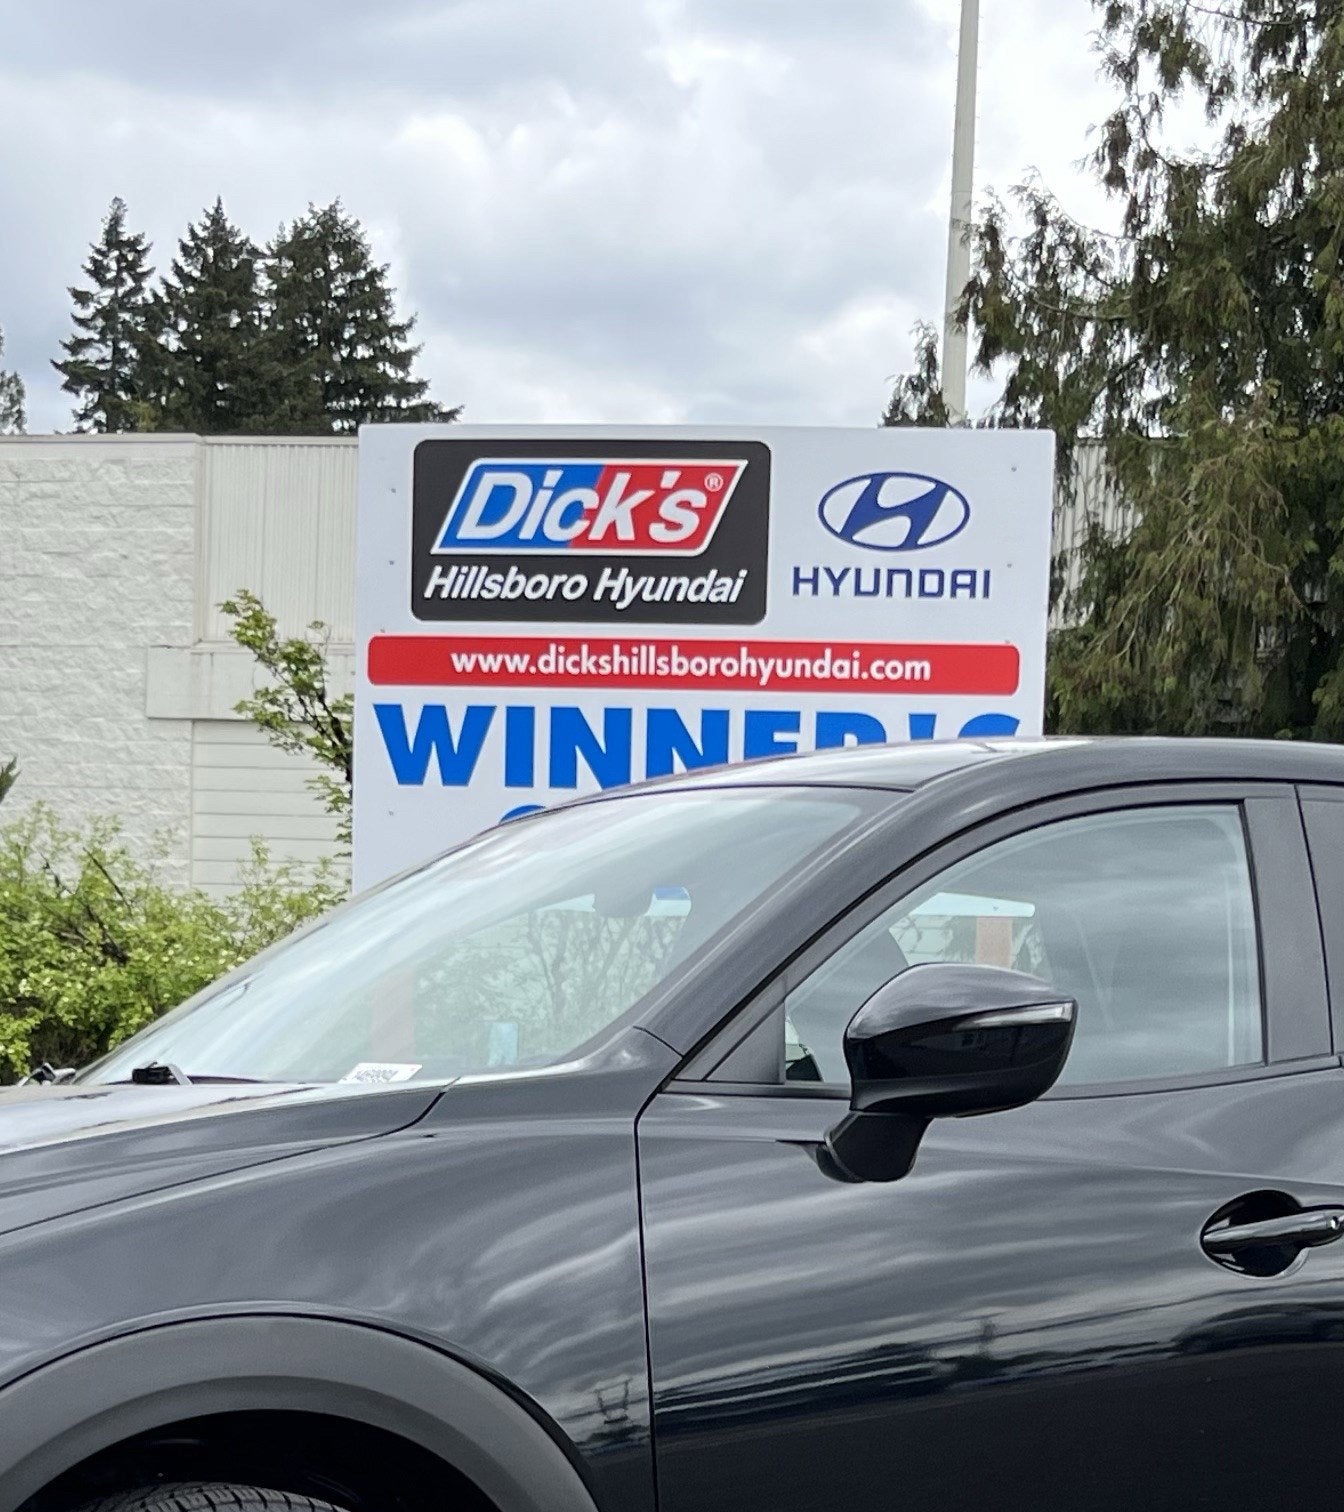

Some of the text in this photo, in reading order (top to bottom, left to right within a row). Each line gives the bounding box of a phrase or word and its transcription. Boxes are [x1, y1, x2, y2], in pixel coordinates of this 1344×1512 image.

[424, 565, 748, 610] Hillsboro Hyundai
[792, 566, 991, 599] HYUNDAI
[451, 643, 931, 685] www.dickshillsborohyundai.com
